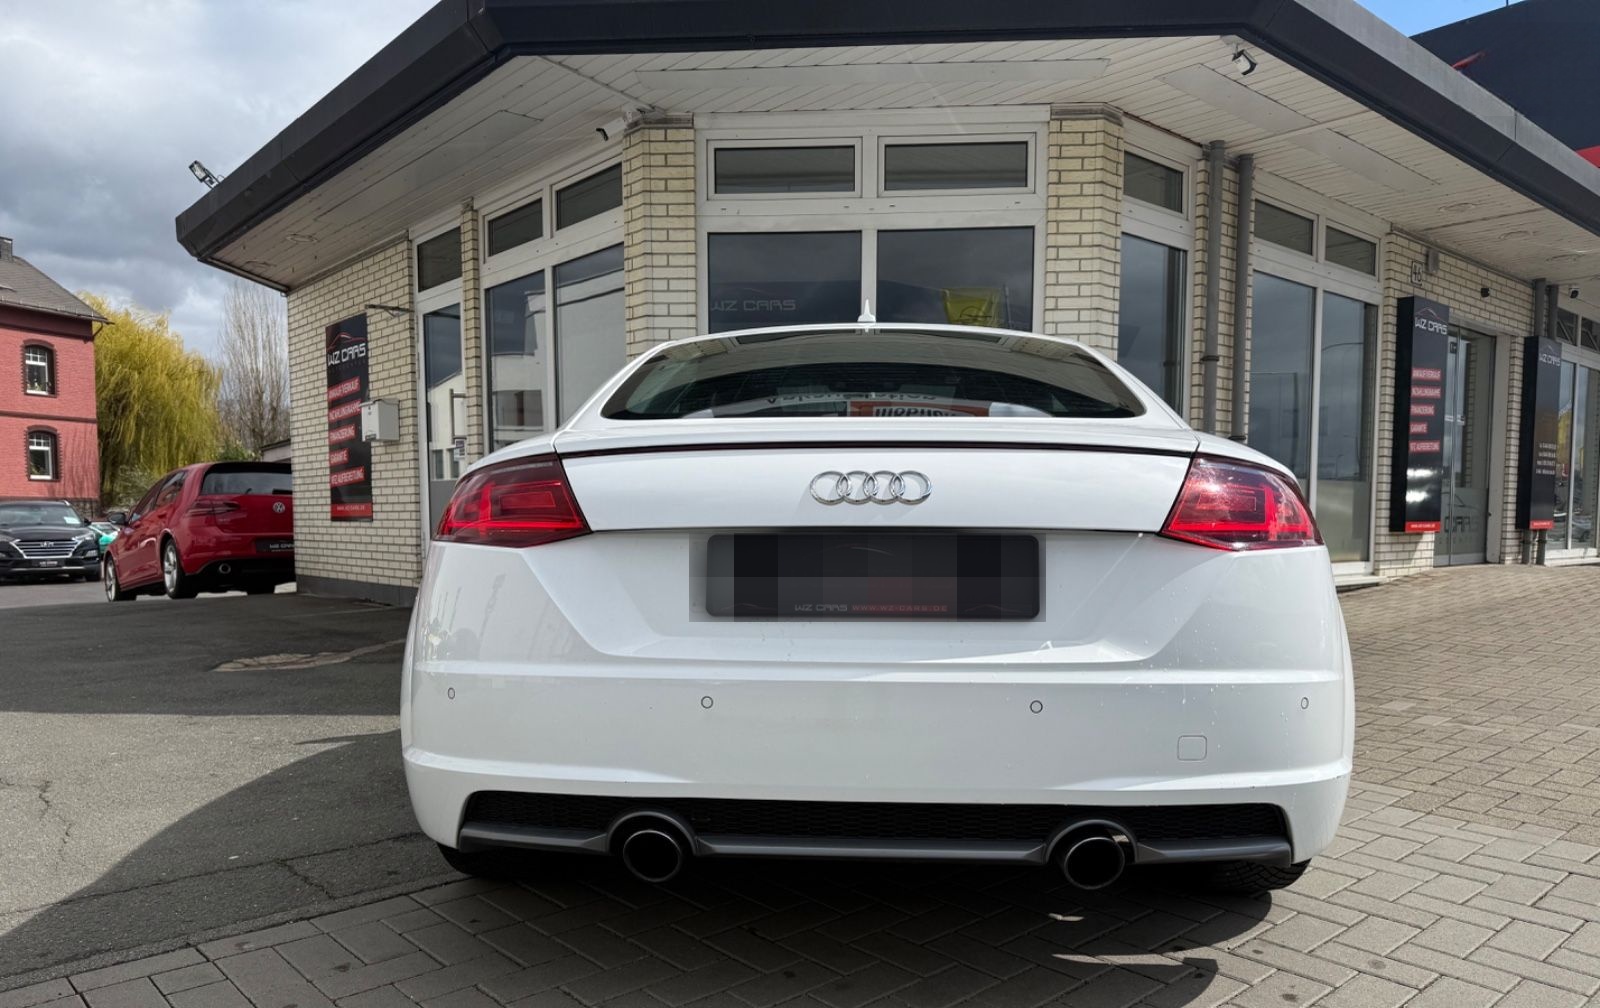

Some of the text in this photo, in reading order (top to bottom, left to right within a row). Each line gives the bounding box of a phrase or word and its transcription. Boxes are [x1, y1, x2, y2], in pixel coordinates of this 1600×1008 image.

[743, 300, 796, 311] CARS
[341, 343, 366, 362] CARS
[795, 604, 813, 612] WZ
[815, 604, 848, 612] CARS
